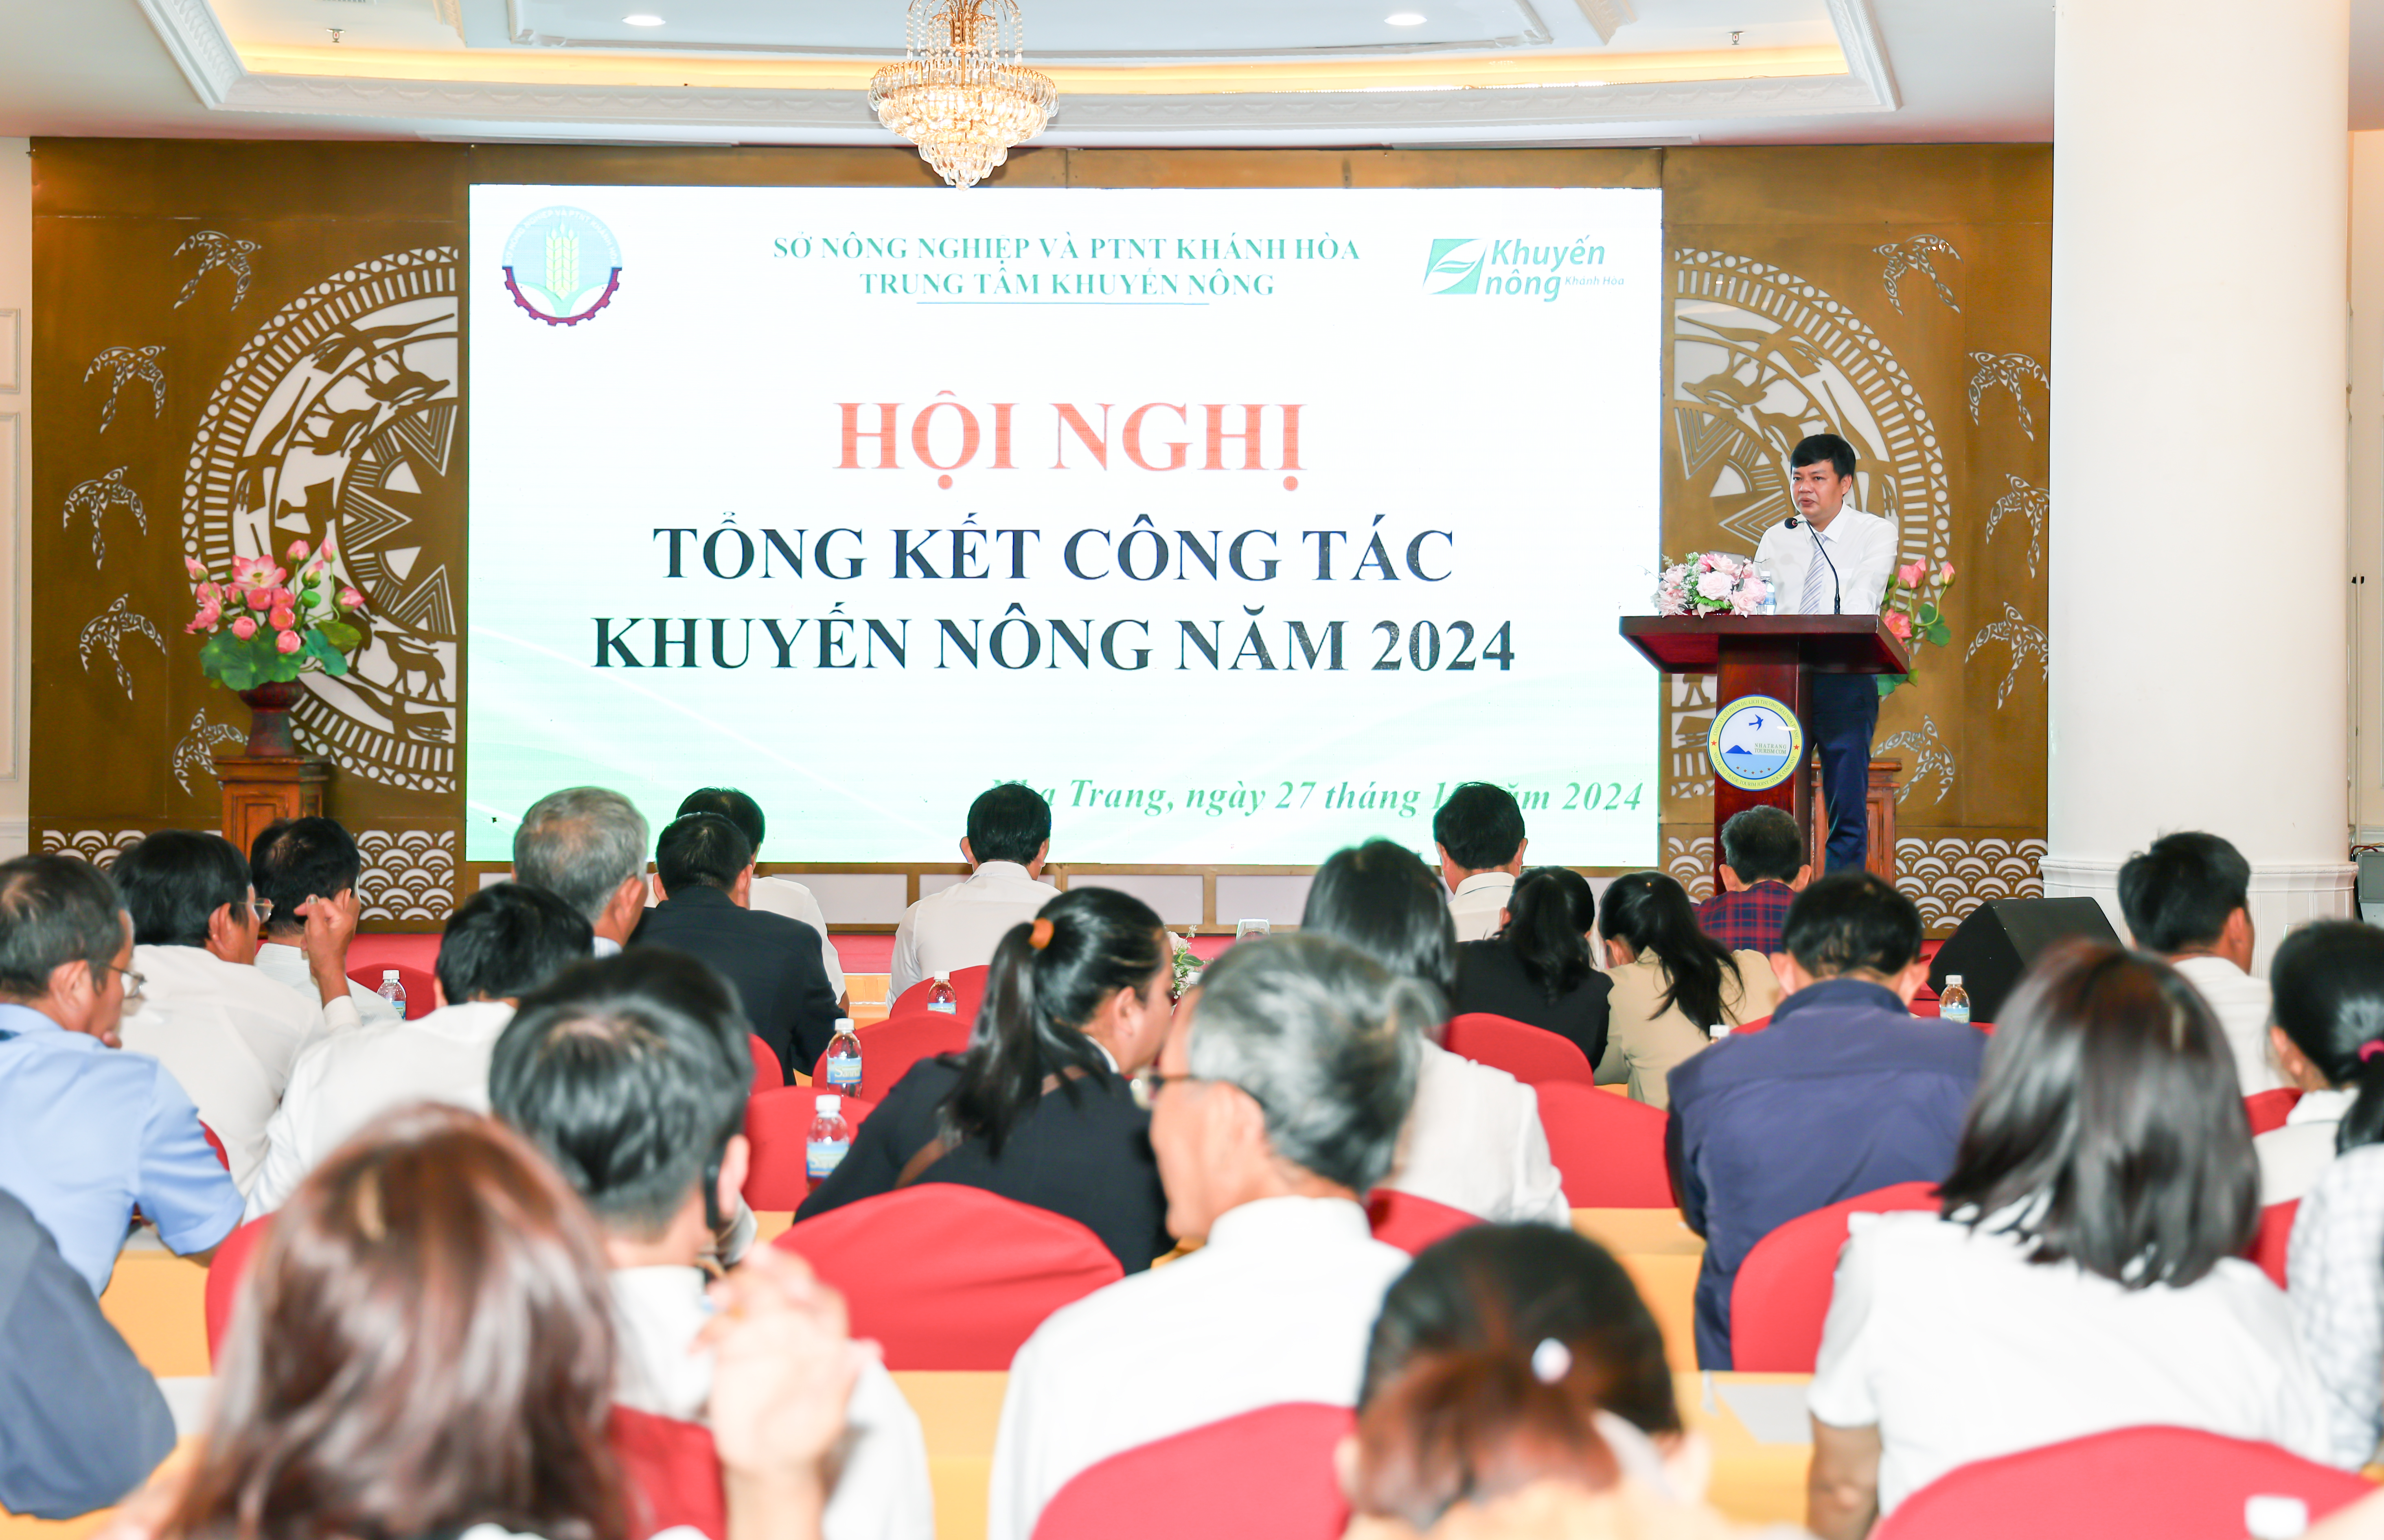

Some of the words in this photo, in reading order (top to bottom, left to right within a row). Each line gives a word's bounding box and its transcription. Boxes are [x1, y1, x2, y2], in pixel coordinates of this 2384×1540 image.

[774, 231, 812, 258] SỞ
[822, 231, 907, 258] NÔNG
[918, 235, 1030, 265] NGHIỆP
[1039, 231, 1079, 258] VÀ
[1091, 238, 1167, 259] PTNT
[1177, 232, 1286, 259] KHÁNH
[1295, 232, 1360, 260] HÒA
[1491, 235, 1605, 273] Khuyến
[859, 273, 964, 294] TRUNG
[973, 267, 1039, 294] TÂM
[1052, 267, 1178, 295] KHUYẾN
[1188, 268, 1274, 295] NÔNG
[1485, 268, 1562, 302] nông
[1565, 276, 1600, 285] Khánh
[833, 389, 1020, 490] HỘI
[1048, 402, 1308, 491] NGHỊ
[653, 511, 868, 580] TỔNG
[889, 512, 1041, 579] KẾT
[1063, 513, 1281, 581] CÔNG
[1302, 514, 1453, 582] TÁC
[590, 602, 912, 669] KHUYẾN
[934, 602, 1153, 671] NÔNG
[1174, 604, 1348, 671] NĂM
[1371, 620, 1516, 672] 2024
[1713, 752, 1727, 774] NHATRANG
[1726, 772, 1740, 783] TRADE
[1770, 773, 1783, 783] STOCK
[1782, 755, 1796, 775] COMPANY
[1070, 779, 1174, 817] Trang,
[1185, 780, 1266, 817] ngày
[1274, 781, 1317, 809] 27
[1325, 781, 1421, 818] tháng
[1507, 781, 1550, 810] ăm
[1562, 781, 1643, 811] 2024
